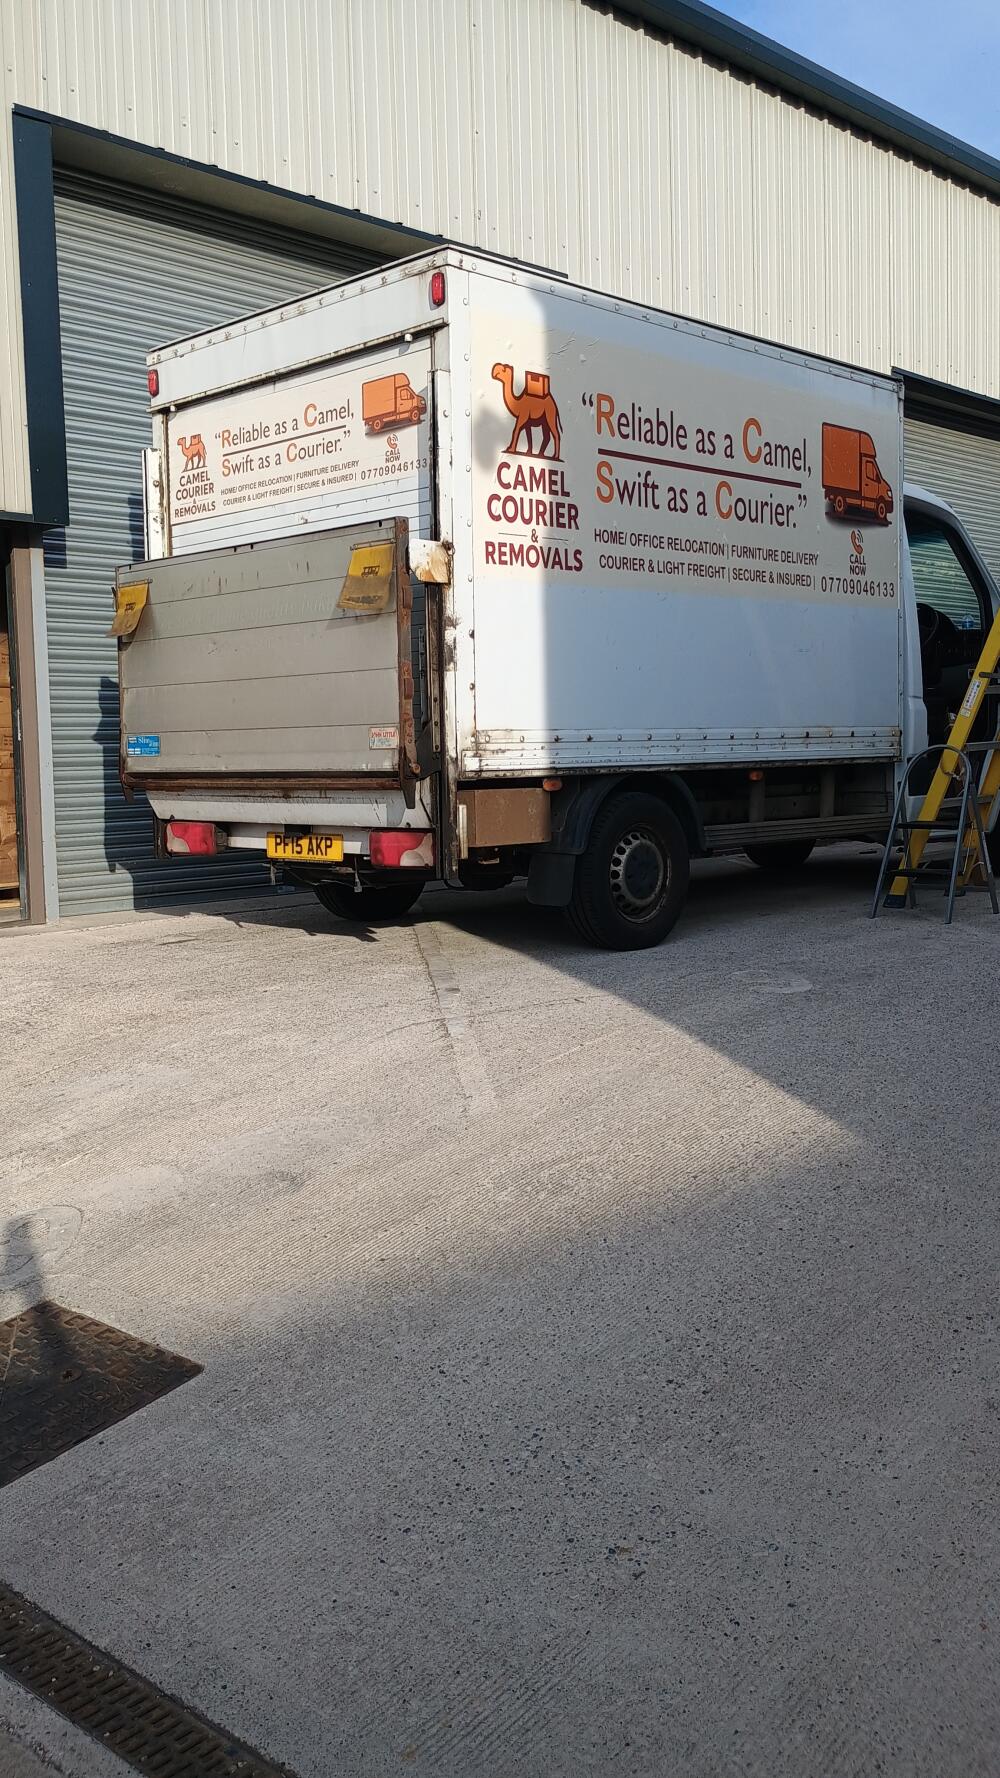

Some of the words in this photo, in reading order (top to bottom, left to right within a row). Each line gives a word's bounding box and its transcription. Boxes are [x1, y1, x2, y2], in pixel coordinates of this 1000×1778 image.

[274, 421, 287, 435] as
[292, 417, 298, 430] a
[304, 399, 354, 427] Camel,
[581, 392, 687, 450] “Reliable
[695, 428, 716, 455] as
[724, 434, 734, 459] a
[742, 418, 812, 477] Camel,
[221, 455, 254, 477] Swift
[258, 454, 270, 469] as
[274, 453, 281, 465] a
[360, 457, 427, 481] 07709046133
[385, 455, 401, 463] NOW
[179, 470, 210, 487] CAMEL
[238, 481, 256, 493] OFFICE
[257, 474, 292, 489] RELOCATION
[296, 466, 329, 481] FURNITURE
[329, 460, 359, 474] DELIVERY
[496, 461, 570, 497] CAMEL
[175, 483, 214, 501] COURIER
[222, 495, 246, 506] COURIER
[252, 490, 269, 500] LIGHT
[269, 486, 293, 498] FREIGHT
[297, 480, 321, 492] SECURE
[321, 478, 326, 486] &
[326, 473, 353, 486] INSURED
[596, 461, 660, 510] Swift
[667, 486, 688, 513] as
[696, 491, 708, 516] a
[715, 481, 807, 529] Courier.”
[174, 501, 216, 518] REMOVALS
[487, 493, 579, 530] COURIER
[531, 529, 538, 543] &
[485, 541, 583, 572] REMOVALS
[629, 533, 665, 550] OFFICE
[667, 537, 725, 556] RELOCATION
[731, 544, 780, 562] FURNITURE
[781, 550, 819, 565] DELIVERY
[849, 554, 866, 565] CALL
[599, 555, 645, 571] COURIER
[648, 559, 655, 572] &
[657, 561, 685, 575] LIGHT
[687, 564, 726, 579] FREIGHT
[732, 569, 767, 584] SECURE
[769, 572, 775, 584] &
[776, 573, 811, 587] INSURED
[849, 564, 866, 576] NOW
[821, 577, 895, 598] 07709046133
[275, 835, 303, 854] PF15
[308, 837, 332, 856] AKP
